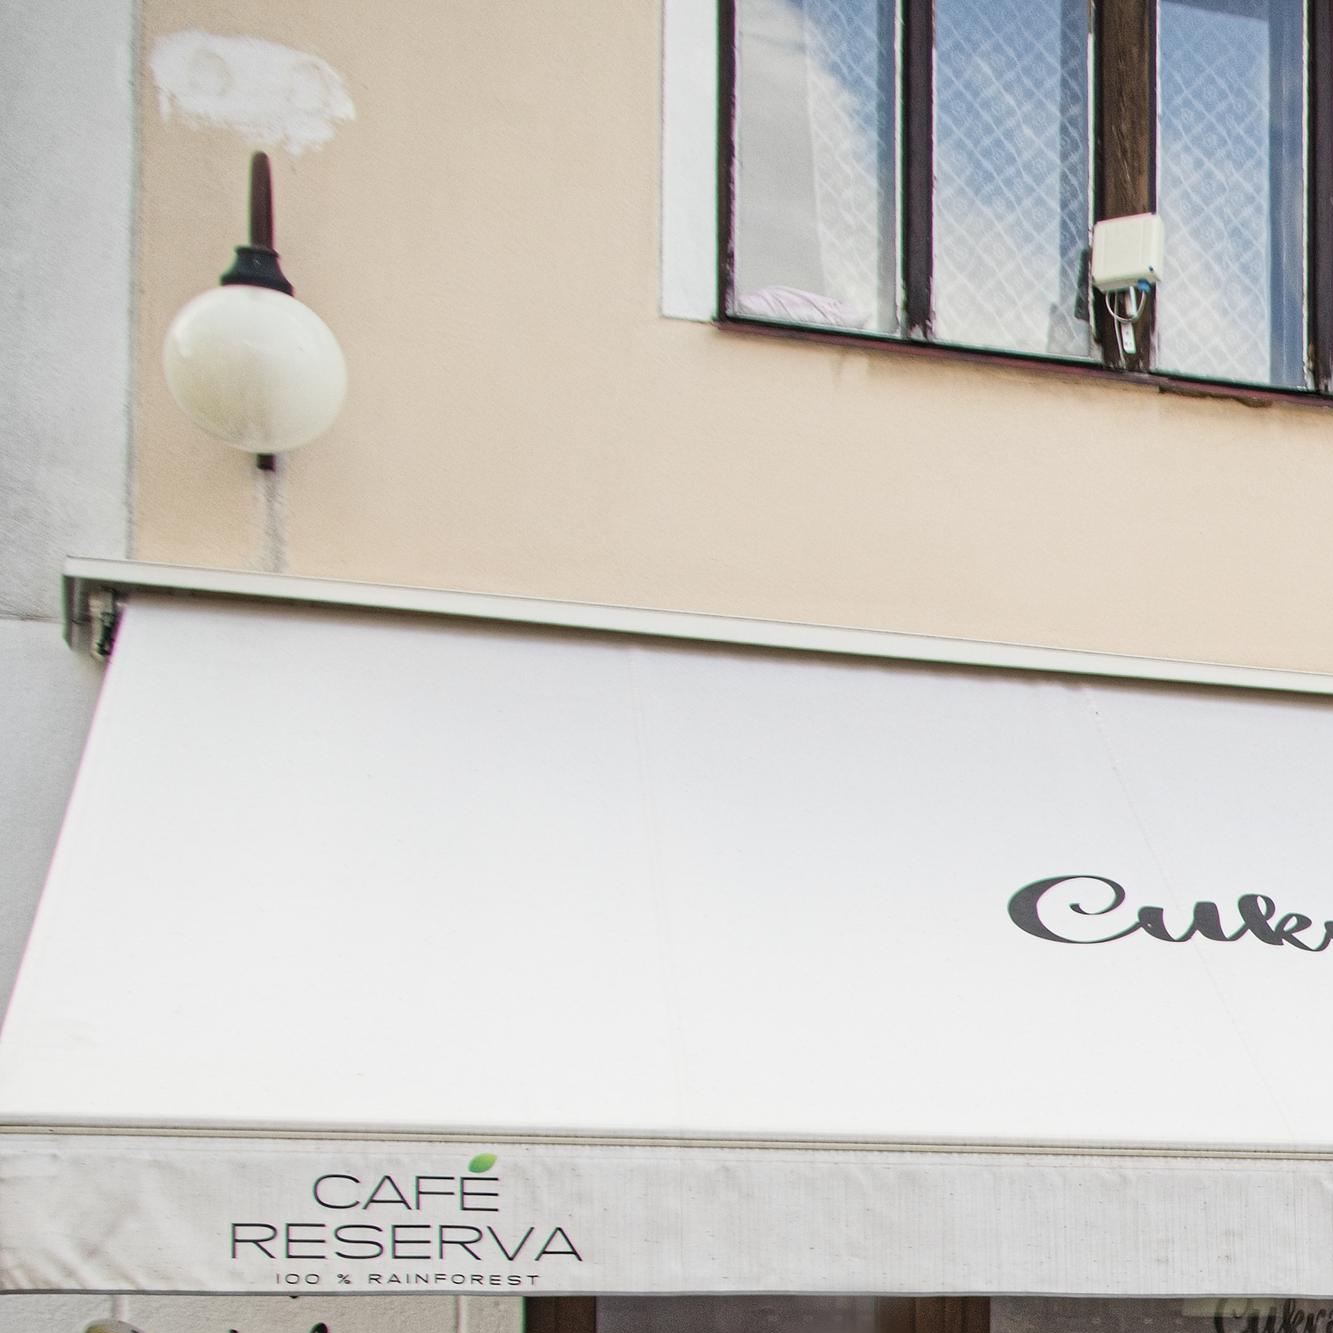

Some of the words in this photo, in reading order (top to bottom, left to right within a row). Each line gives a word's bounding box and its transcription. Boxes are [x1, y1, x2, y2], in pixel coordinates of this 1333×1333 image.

[313, 1153, 500, 1213] CAFÉ
[231, 1222, 582, 1262] RESERVA
[276, 1273, 320, 1285] 100
[336, 1273, 352, 1285] %
[368, 1273, 540, 1286] RAINFOREST
